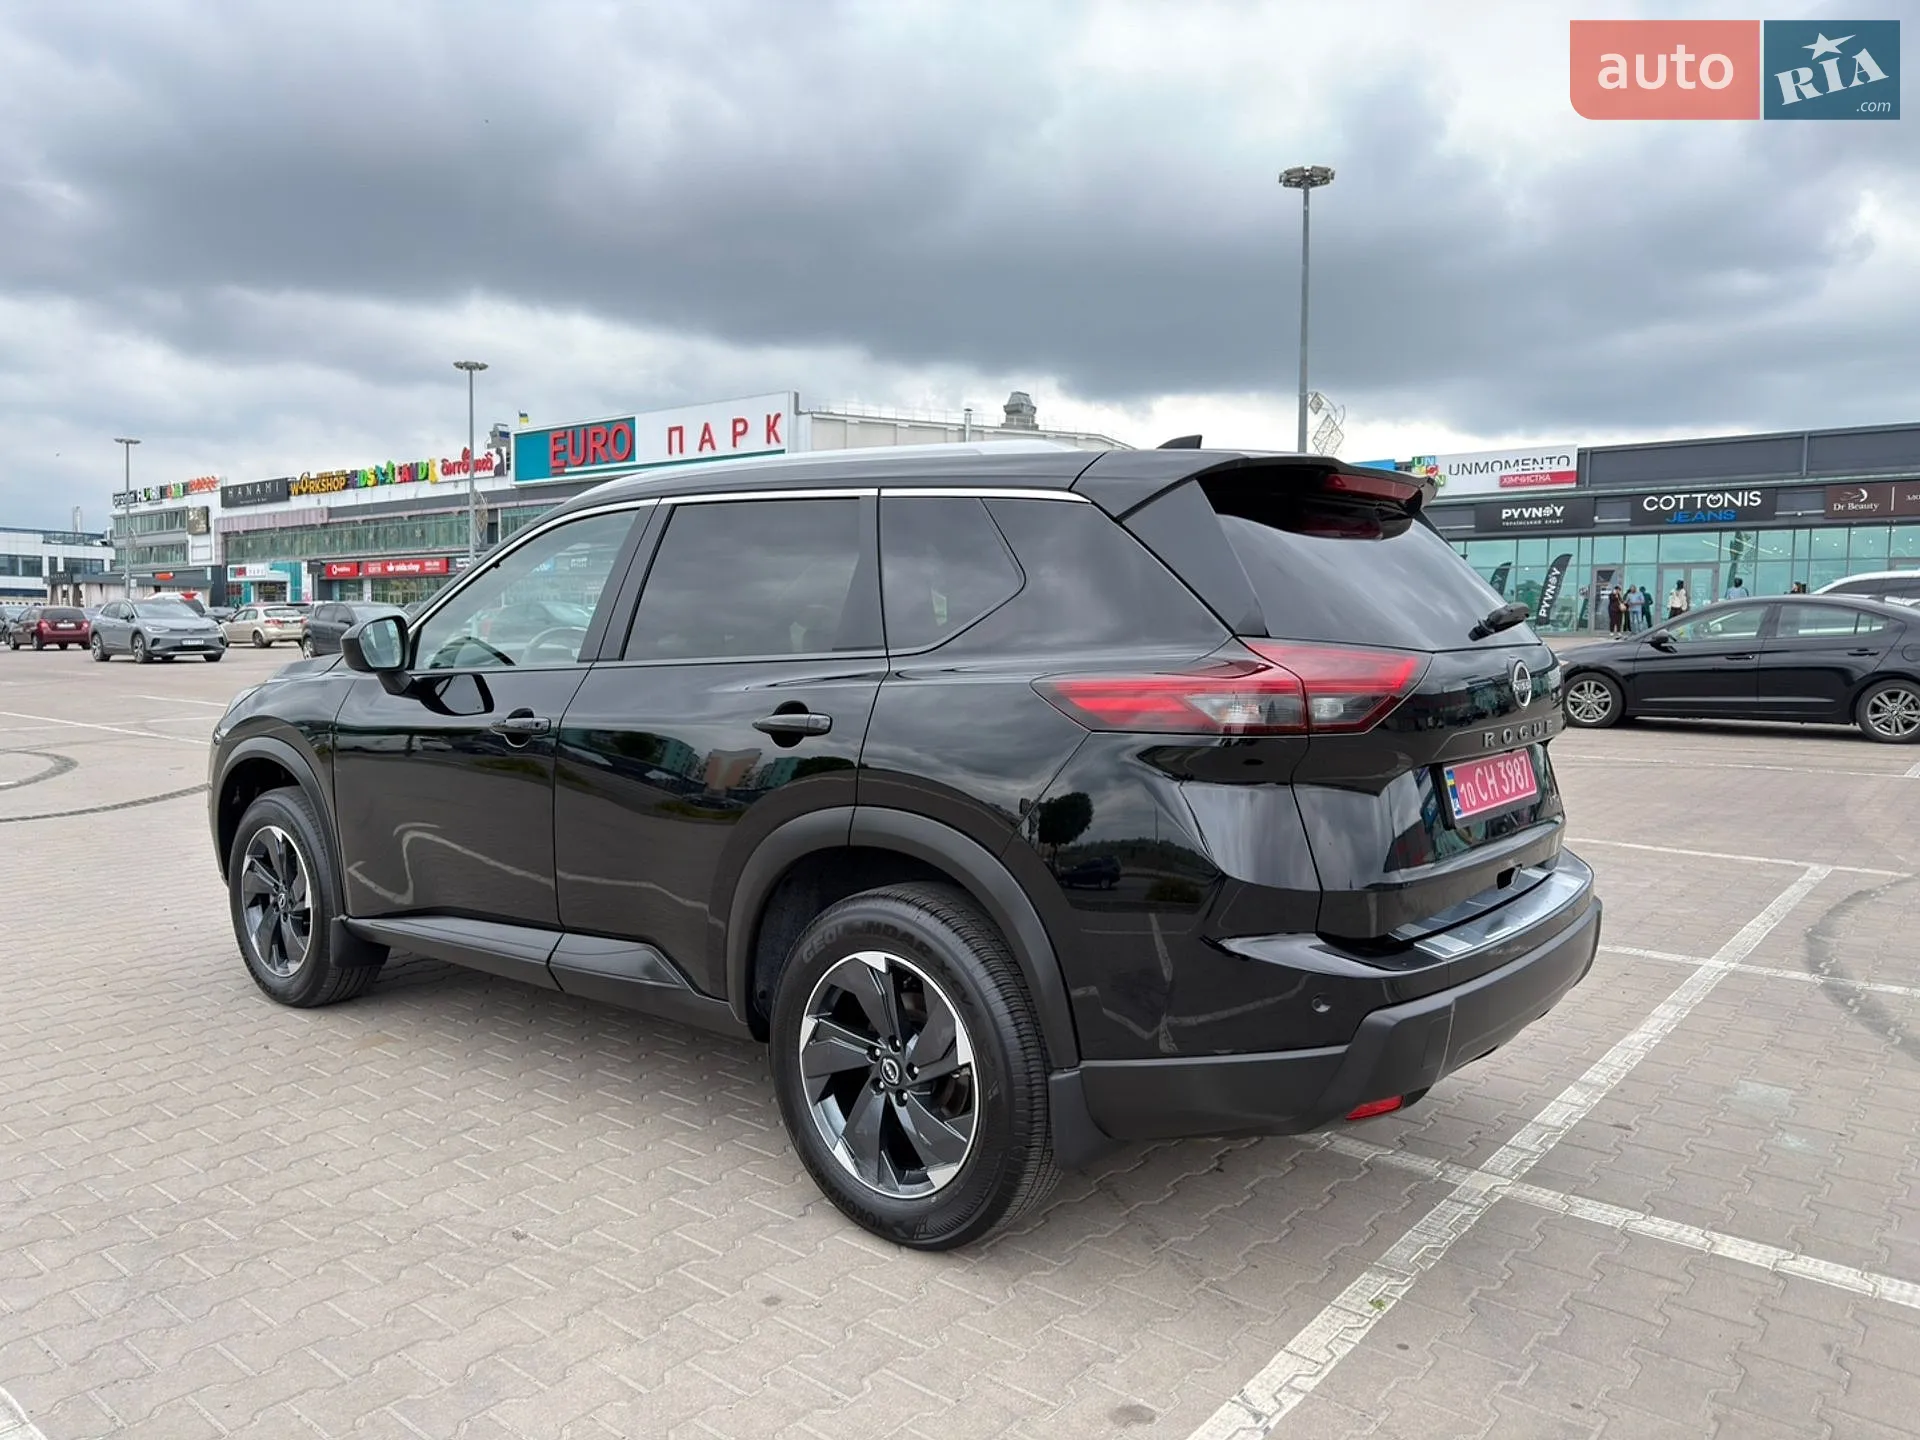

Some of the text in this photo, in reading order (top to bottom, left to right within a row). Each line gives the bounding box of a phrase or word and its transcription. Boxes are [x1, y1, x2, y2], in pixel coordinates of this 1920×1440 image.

[551, 412, 782, 468] EURO ПАРК
[1448, 455, 1571, 476] UNMOMENTO
[227, 481, 279, 498] HANAMI
[1643, 490, 1762, 511] COTTONIS
[1833, 502, 1879, 512] Dr Beauty
[1666, 509, 1737, 524] JEANS
[1482, 719, 1553, 748] ROGUE
[1460, 781, 1476, 809] 10
[1497, 755, 1530, 796] 3987
